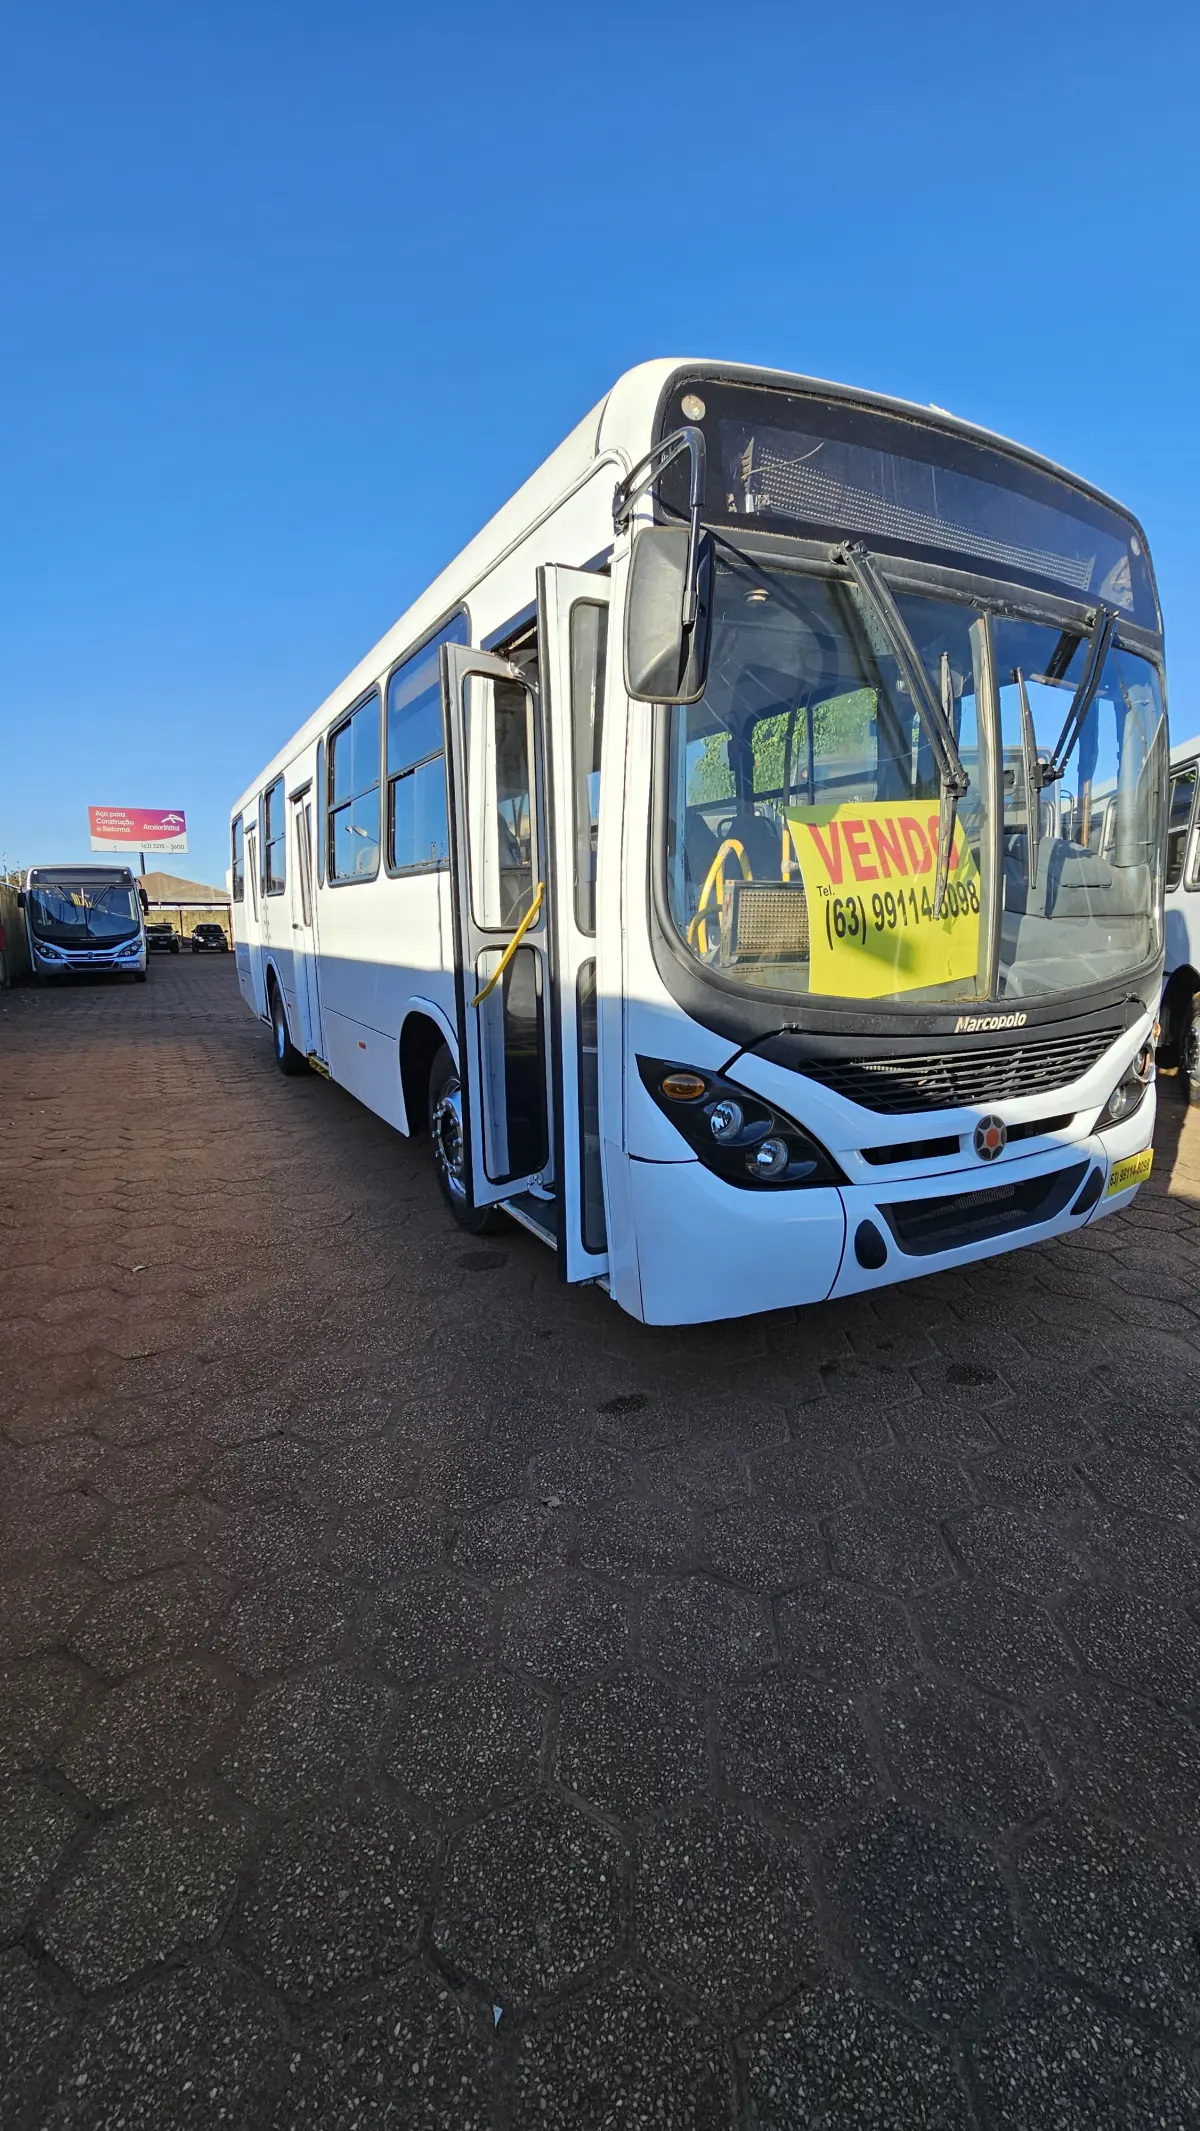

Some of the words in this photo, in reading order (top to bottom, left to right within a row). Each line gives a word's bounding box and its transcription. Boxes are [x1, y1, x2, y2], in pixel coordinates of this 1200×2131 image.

[96, 810, 108, 818] Aço
[96, 818, 134, 826] Construção
[143, 823, 180, 832] ArcelorMittal
[816, 885, 835, 898] Tel.
[826, 895, 867, 950] (63)
[953, 1011, 1027, 1034] Marcopolo
